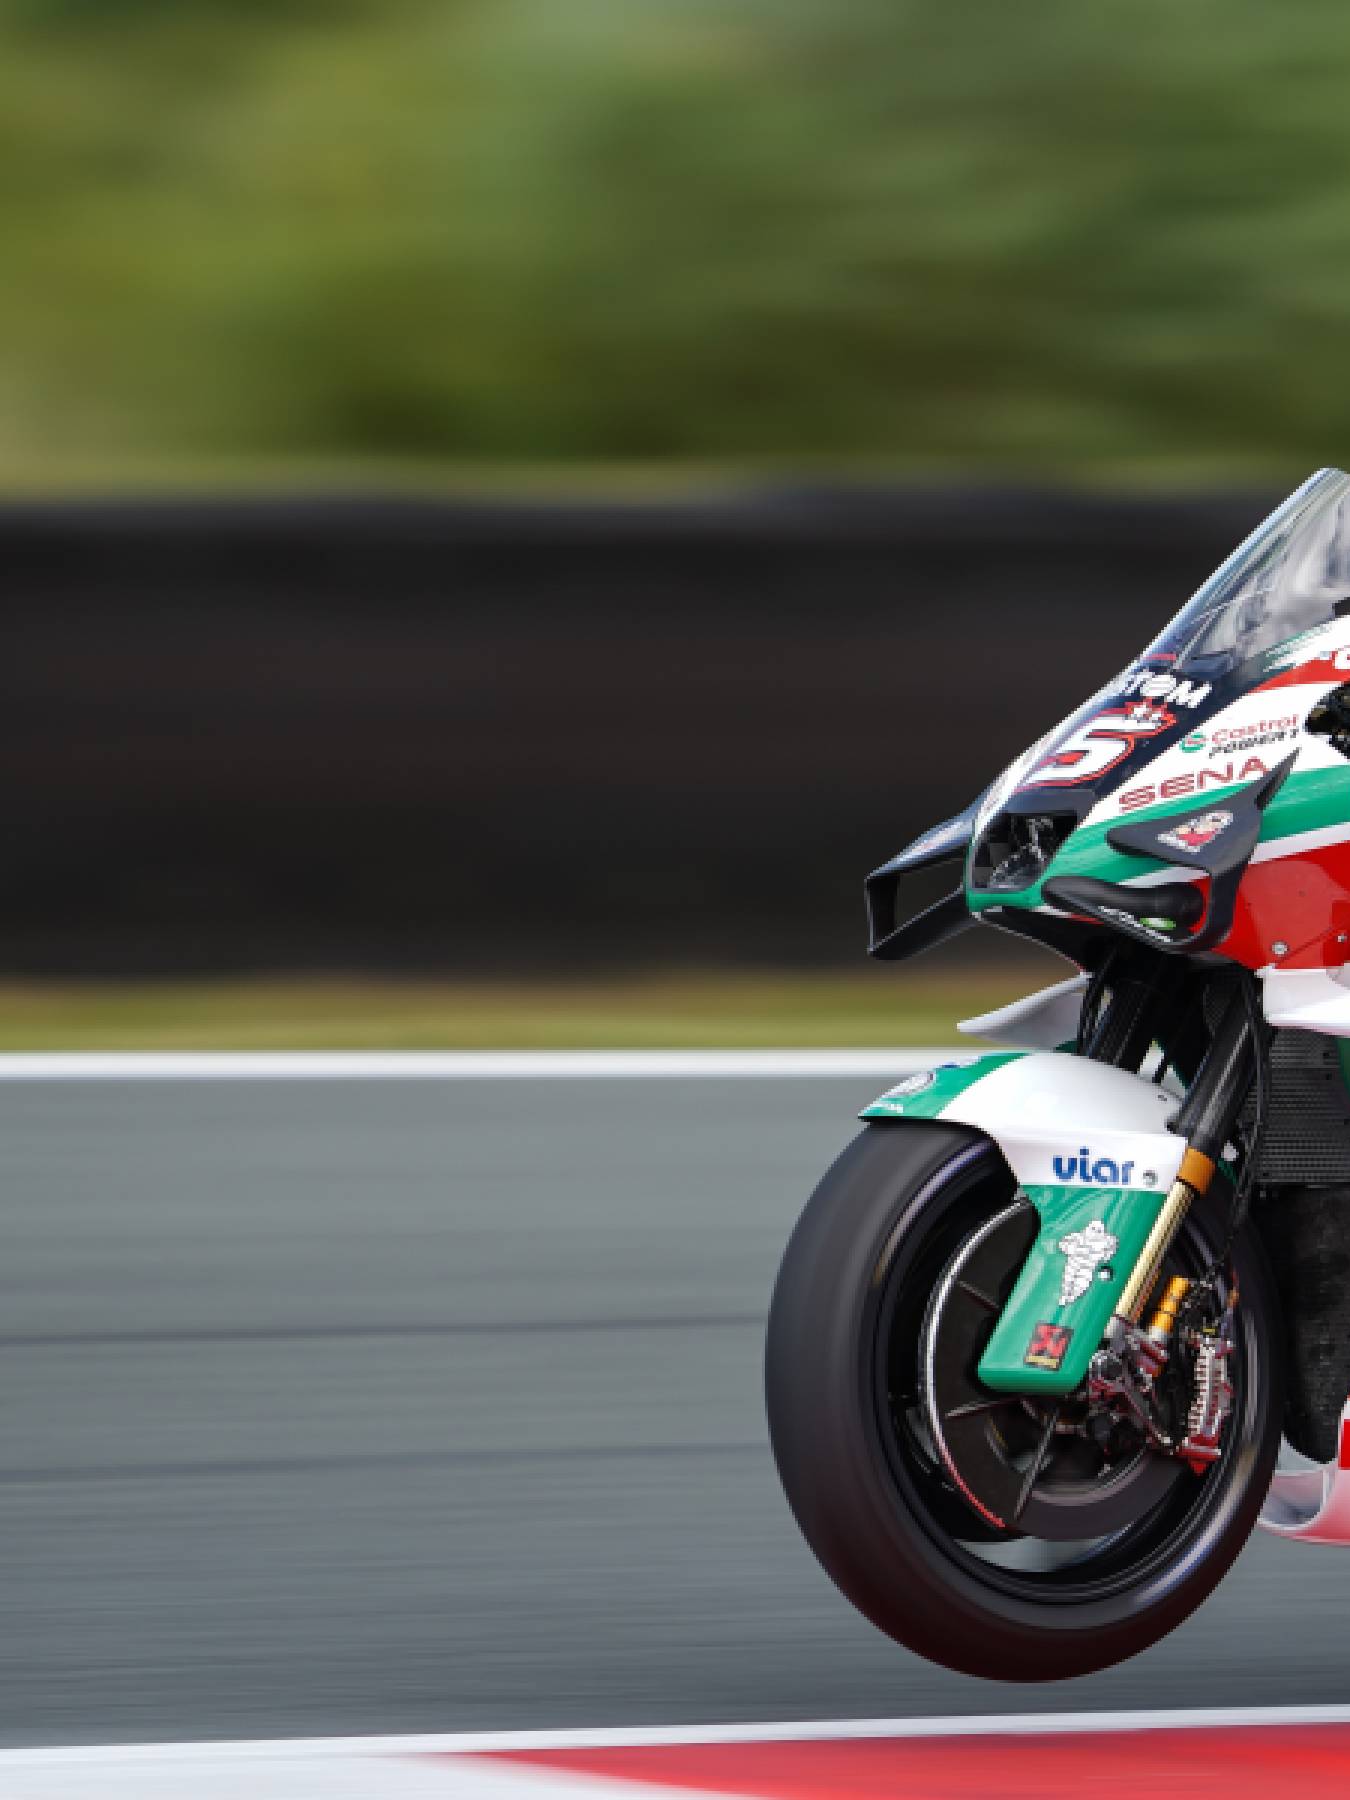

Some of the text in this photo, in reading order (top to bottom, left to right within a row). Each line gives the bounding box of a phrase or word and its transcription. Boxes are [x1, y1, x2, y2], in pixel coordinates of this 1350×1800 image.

[1014, 706, 1178, 790] 5
[1212, 714, 1300, 744] Castrol
[1118, 756, 1270, 811] SENA
[1052, 1146, 1135, 1185] viar
